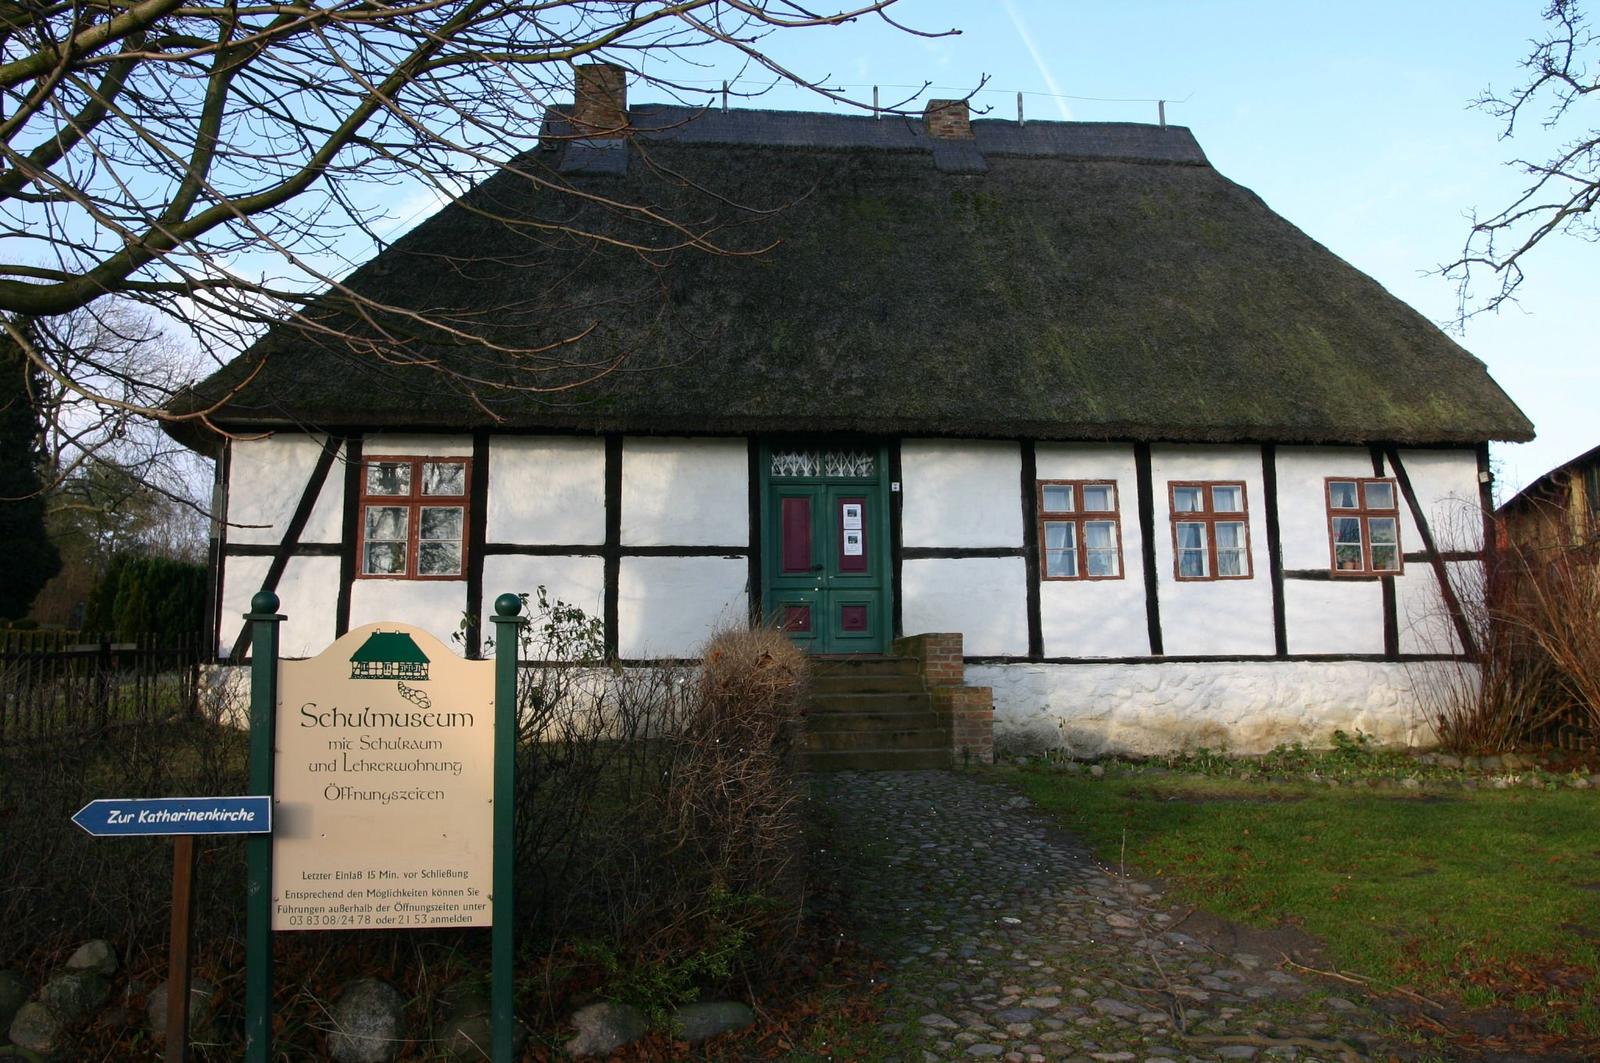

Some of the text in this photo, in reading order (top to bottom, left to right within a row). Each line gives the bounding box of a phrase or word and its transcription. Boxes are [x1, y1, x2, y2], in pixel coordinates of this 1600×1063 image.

[300, 702, 474, 728] Schulmuseum
[328, 734, 443, 751] mit Schulraum
[308, 752, 463, 776] und Lehrerwohnung
[324, 783, 445, 805] Öffnungszeiten
[107, 808, 255, 824] Zur Katharinenkirche
[302, 869, 469, 880] Letzter Einlaß 15 Min. vor Schließung
[285, 887, 480, 900] Entsprechend den Möglichkeiten können Sie
[277, 901, 487, 915] Führungen außerhalb der Öffnungszeiten unter
[289, 915, 303, 926] 03
[306, 915, 320, 925] 83
[357, 915, 371, 925] 78
[375, 915, 395, 924] oder
[414, 914, 428, 924] 53
[430, 914, 473, 923] anmelden
